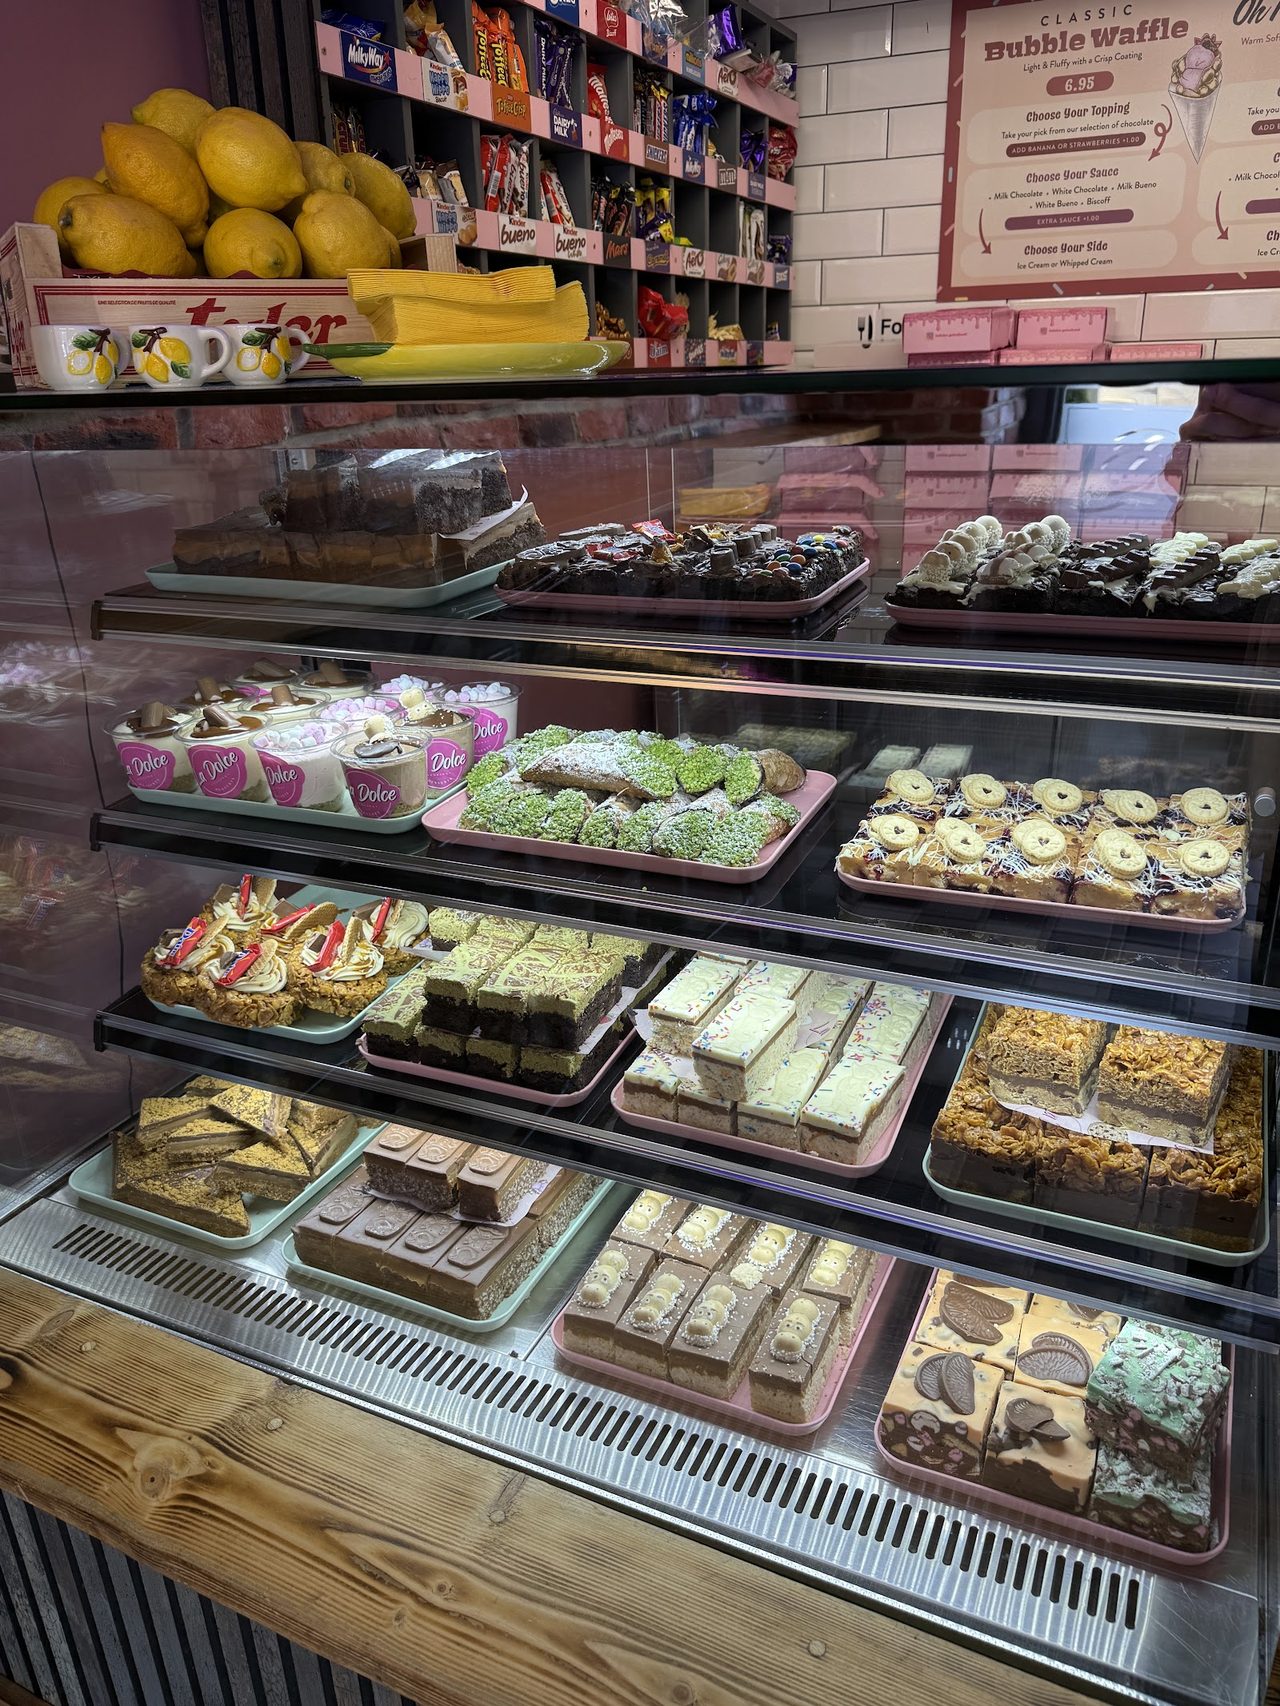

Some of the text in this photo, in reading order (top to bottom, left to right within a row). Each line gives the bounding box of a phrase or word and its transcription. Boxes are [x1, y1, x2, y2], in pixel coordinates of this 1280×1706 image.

[1041, 5, 1133, 26] CLASSIC
[1233, 0, 1271, 26] Oh
[984, 17, 1189, 62] Bubble Waffle
[1241, 36, 1264, 46] Warm
[1023, 62, 1041, 74] Light
[1042, 61, 1048, 69] &
[1050, 58, 1071, 70] Fluffy
[1072, 56, 1087, 66] with
[1094, 54, 1113, 65] Crisp
[1114, 51, 1143, 62] Coating
[1064, 75, 1095, 92] 6.95
[1026, 102, 1131, 123] Choose Your Topping
[1248, 106, 1280, 116] Take you
[553, 115, 570, 128] DAIRY
[1002, 131, 1016, 140] Take
[1016, 131, 1033, 140] your
[1033, 128, 1048, 139] pick
[1049, 127, 1066, 136] from
[1079, 122, 1110, 132] selection
[1111, 120, 1120, 129] of
[1120, 118, 1154, 128] chocolate
[554, 125, 569, 138] MILK
[1011, 146, 1026, 154] ADD
[1027, 144, 1056, 153] BANANA
[1057, 142, 1068, 150] OR
[1069, 138, 1121, 149] STRAWBERRIES
[1026, 167, 1120, 184] Choose Your Sauce
[1234, 174, 1252, 182] Milk
[993, 181, 1158, 200] Milk Chocolate White Chocolate Milk Bueno
[1035, 196, 1112, 210] White Bueno Biscoff
[508, 216, 526, 228] Kinder
[1037, 218, 1058, 226] EXTRA
[1059, 216, 1082, 224] SAUCE
[501, 224, 536, 246] bueno
[556, 234, 586, 253] bueno
[606, 240, 628, 260] Mars
[1024, 240, 1108, 256] Choose Your Side
[1016, 262, 1027, 270] Ice
[1028, 262, 1050, 270] Cream
[1060, 260, 1090, 270] Whipped
[1090, 258, 1113, 266] Cream
[881, 319, 902, 335] Fo
[474, 720, 504, 741] Dolce
[132, 753, 169, 777] Dolce
[203, 752, 239, 780] Dolce
[431, 749, 467, 772] Dolce
[265, 764, 298, 786] Dolce
[358, 780, 397, 802] Dolce
